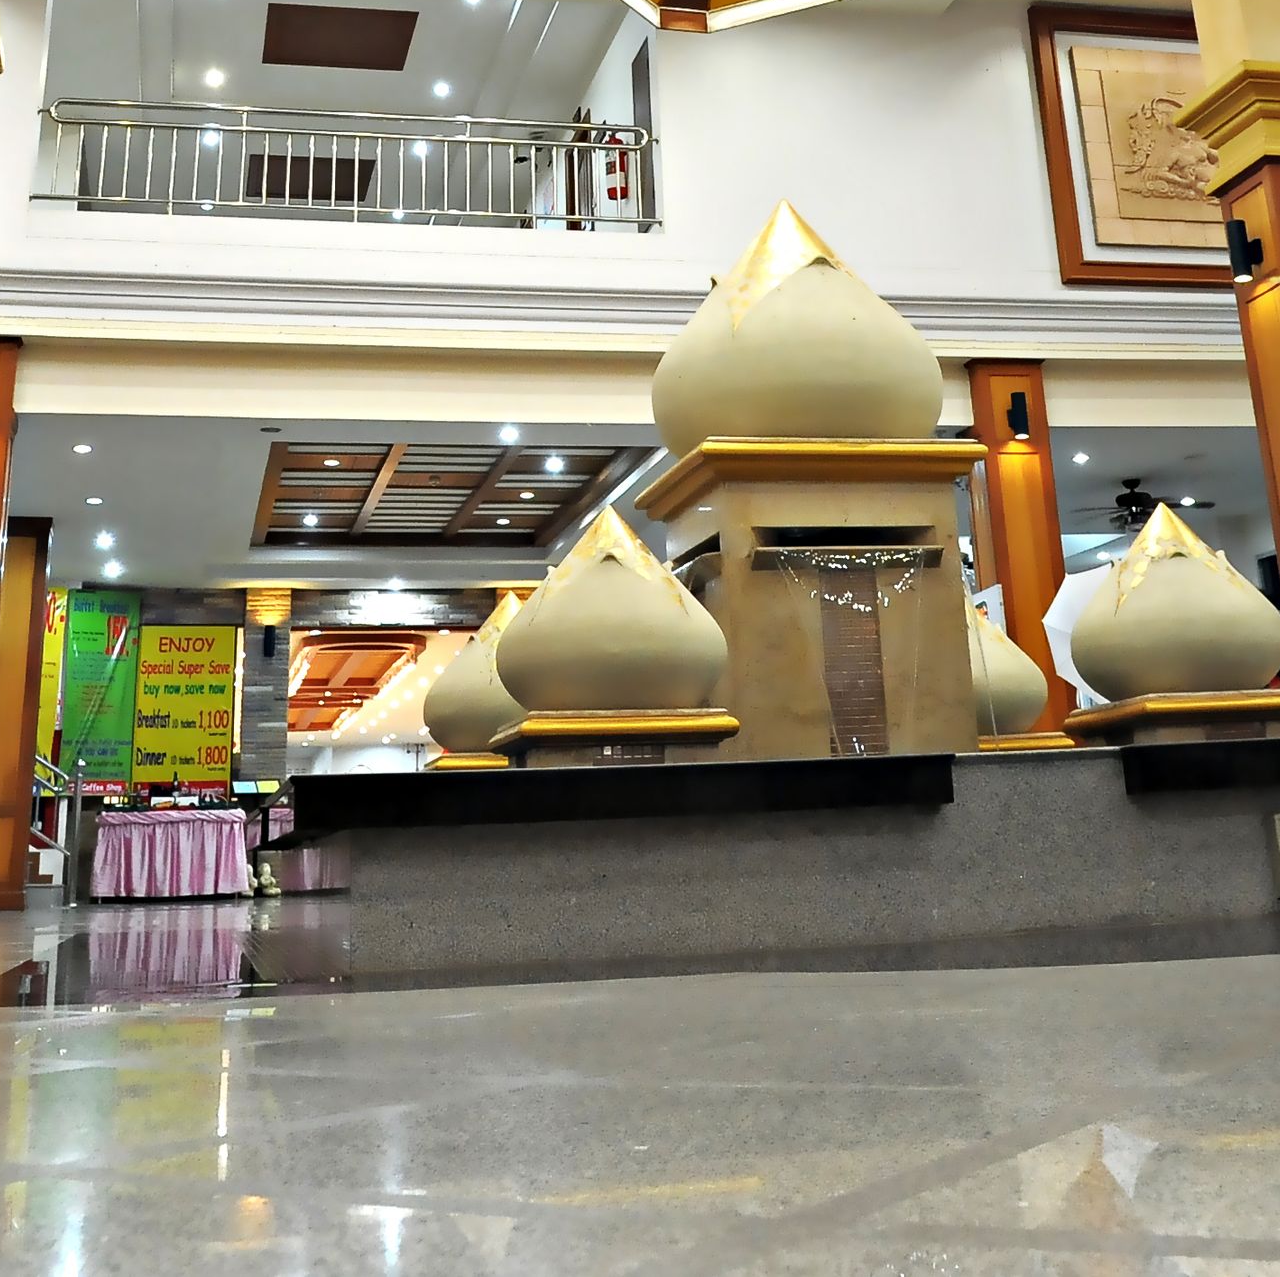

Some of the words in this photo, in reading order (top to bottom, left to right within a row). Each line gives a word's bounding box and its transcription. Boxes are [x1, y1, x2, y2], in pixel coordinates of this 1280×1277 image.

[158, 636, 215, 653] ENJOY
[140, 659, 174, 679] Special
[177, 659, 205, 679] Super
[208, 659, 231, 675] Save
[143, 681, 160, 698] buy
[208, 684, 226, 695] now
[136, 708, 171, 729] Breakfast
[198, 709, 230, 732] 1,100
[136, 747, 167, 766] Dinner
[197, 745, 228, 768] 1,800
[82, 783, 104, 791] Coffee
[106, 783, 122, 793] Shop
